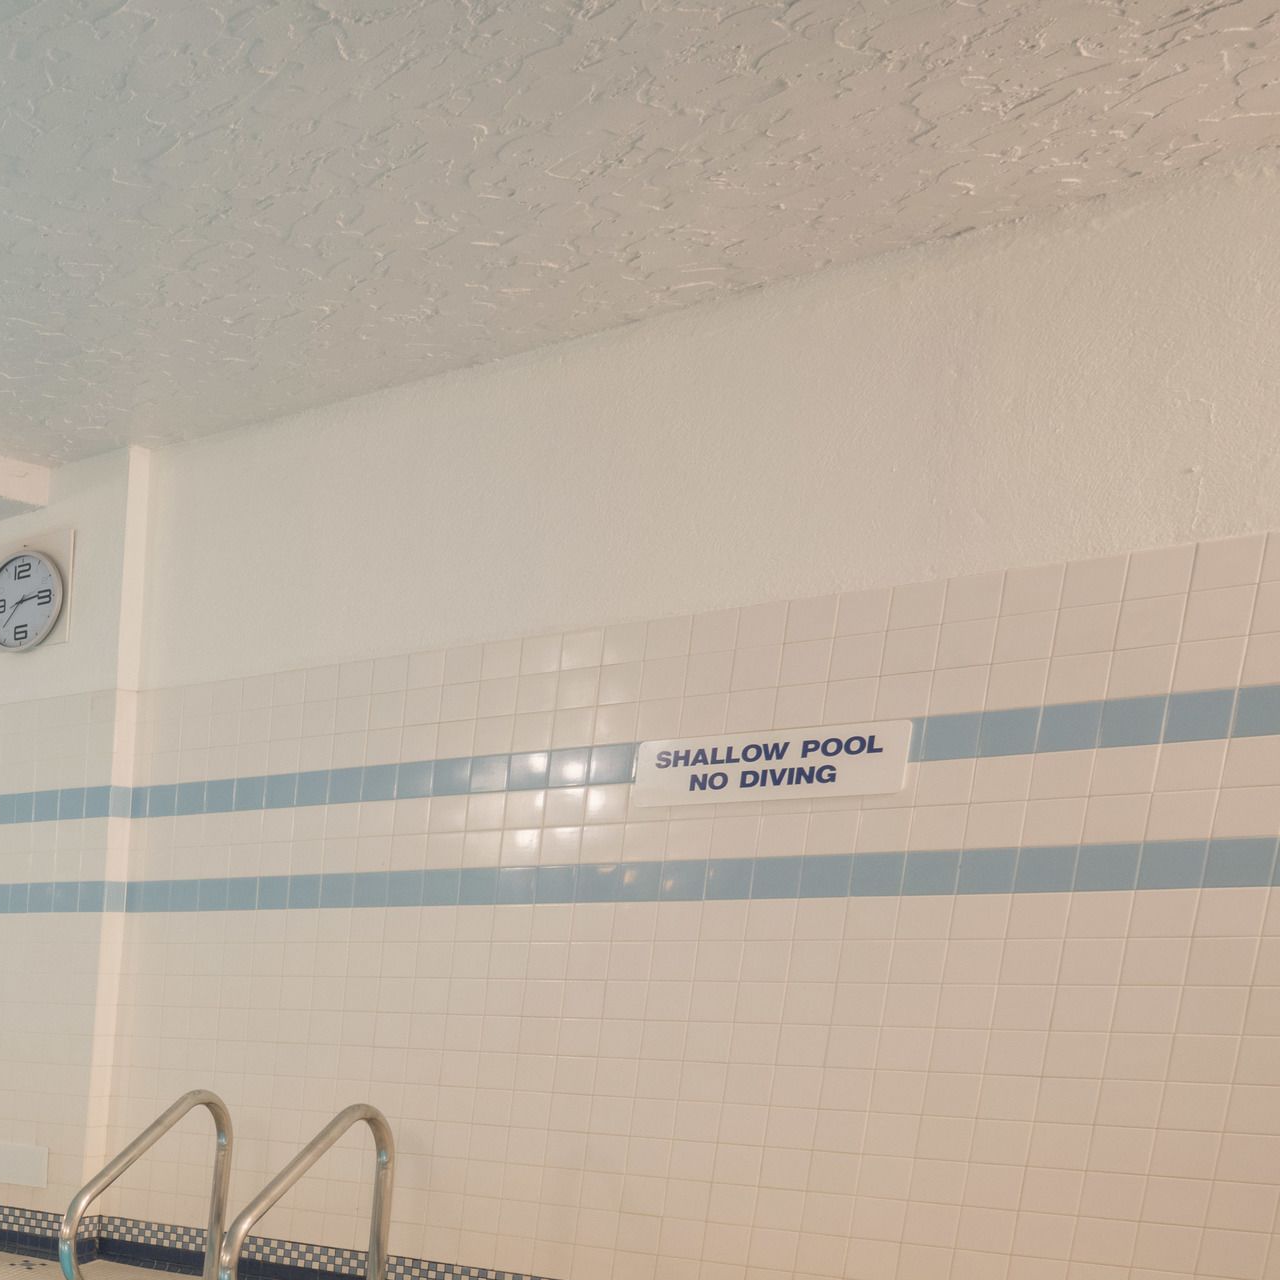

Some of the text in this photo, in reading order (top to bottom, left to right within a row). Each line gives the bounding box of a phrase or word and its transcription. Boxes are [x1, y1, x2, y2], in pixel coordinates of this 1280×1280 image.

[14, 563, 32, 581] 12
[37, 588, 52, 606] 3
[13, 624, 28, 641] 6
[655, 735, 884, 769] SHALLOW POOL
[688, 764, 837, 792] NO DIVING
